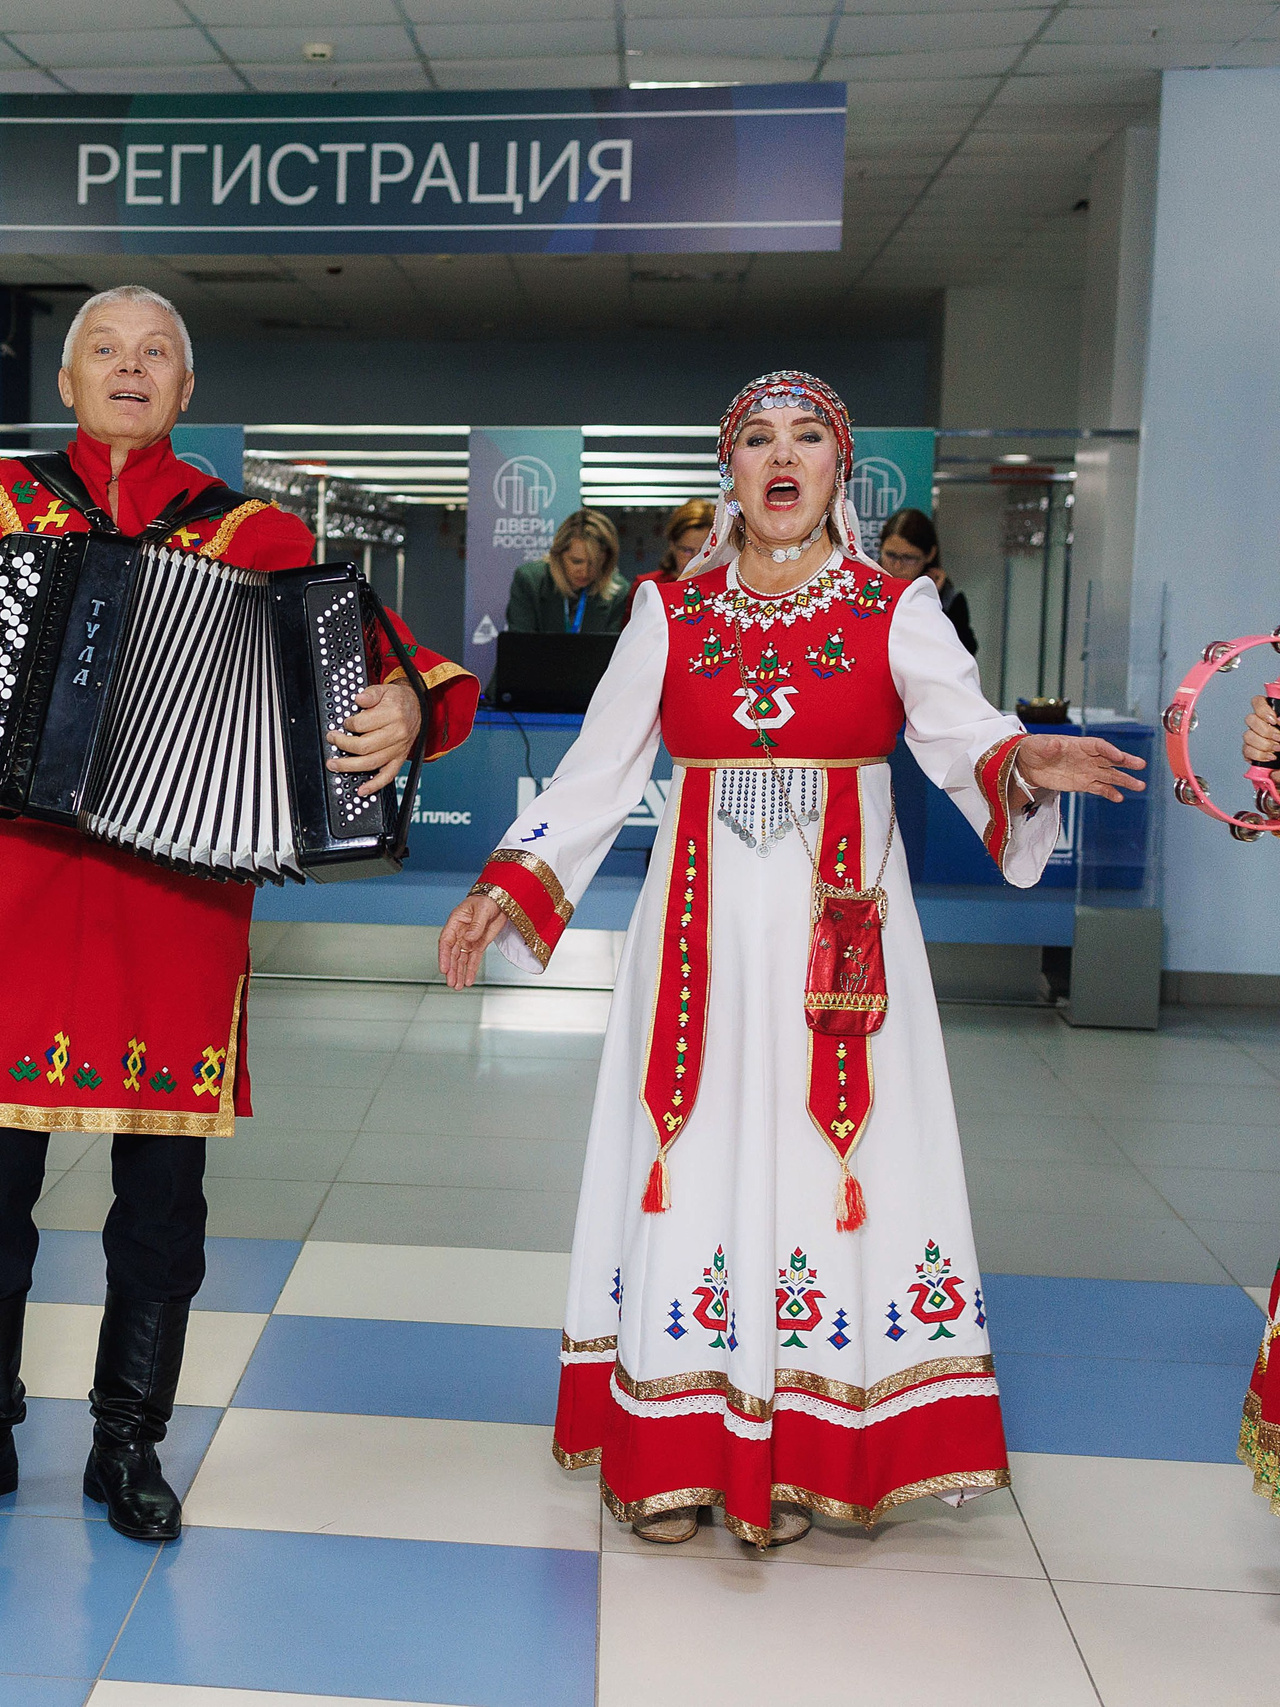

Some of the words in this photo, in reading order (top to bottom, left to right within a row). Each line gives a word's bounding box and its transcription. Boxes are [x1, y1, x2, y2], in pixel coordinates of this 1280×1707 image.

[77, 138, 634, 214] РЕГИСТРАЦИЯ
[493, 517, 555, 535] ДВЕРИ
[72, 599, 106, 686] ТУЛА
[422, 811, 472, 825] ПЛЮС
